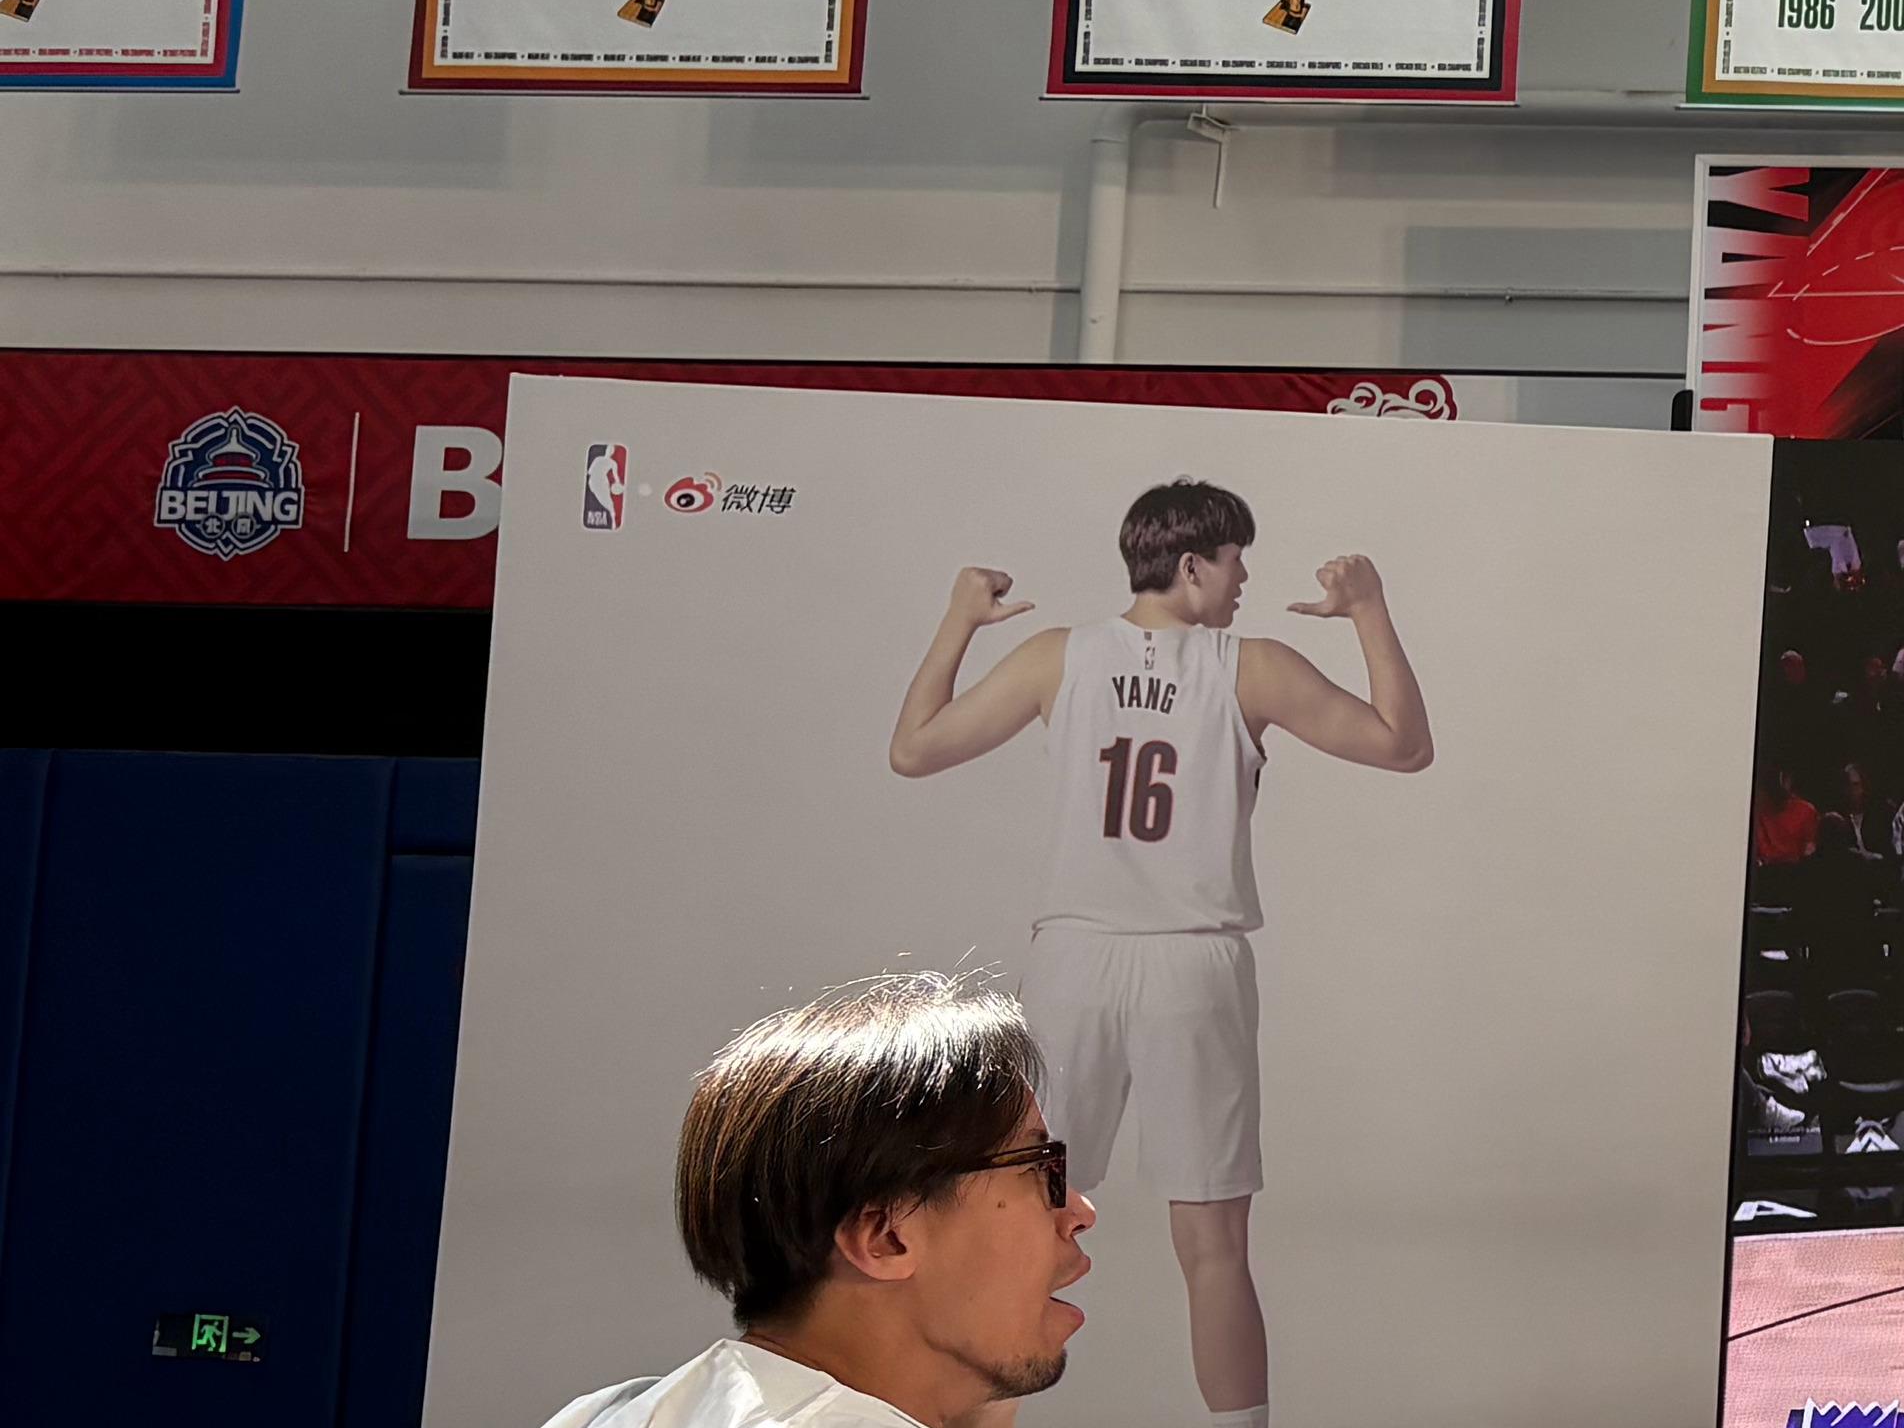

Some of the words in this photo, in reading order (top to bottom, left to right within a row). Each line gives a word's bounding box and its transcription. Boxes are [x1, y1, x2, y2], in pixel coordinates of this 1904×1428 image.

[159, 489, 298, 522] BEIJING
[720, 483, 797, 515] 微博
[1111, 674, 1178, 715] YANG
[1100, 736, 1179, 843] 16
